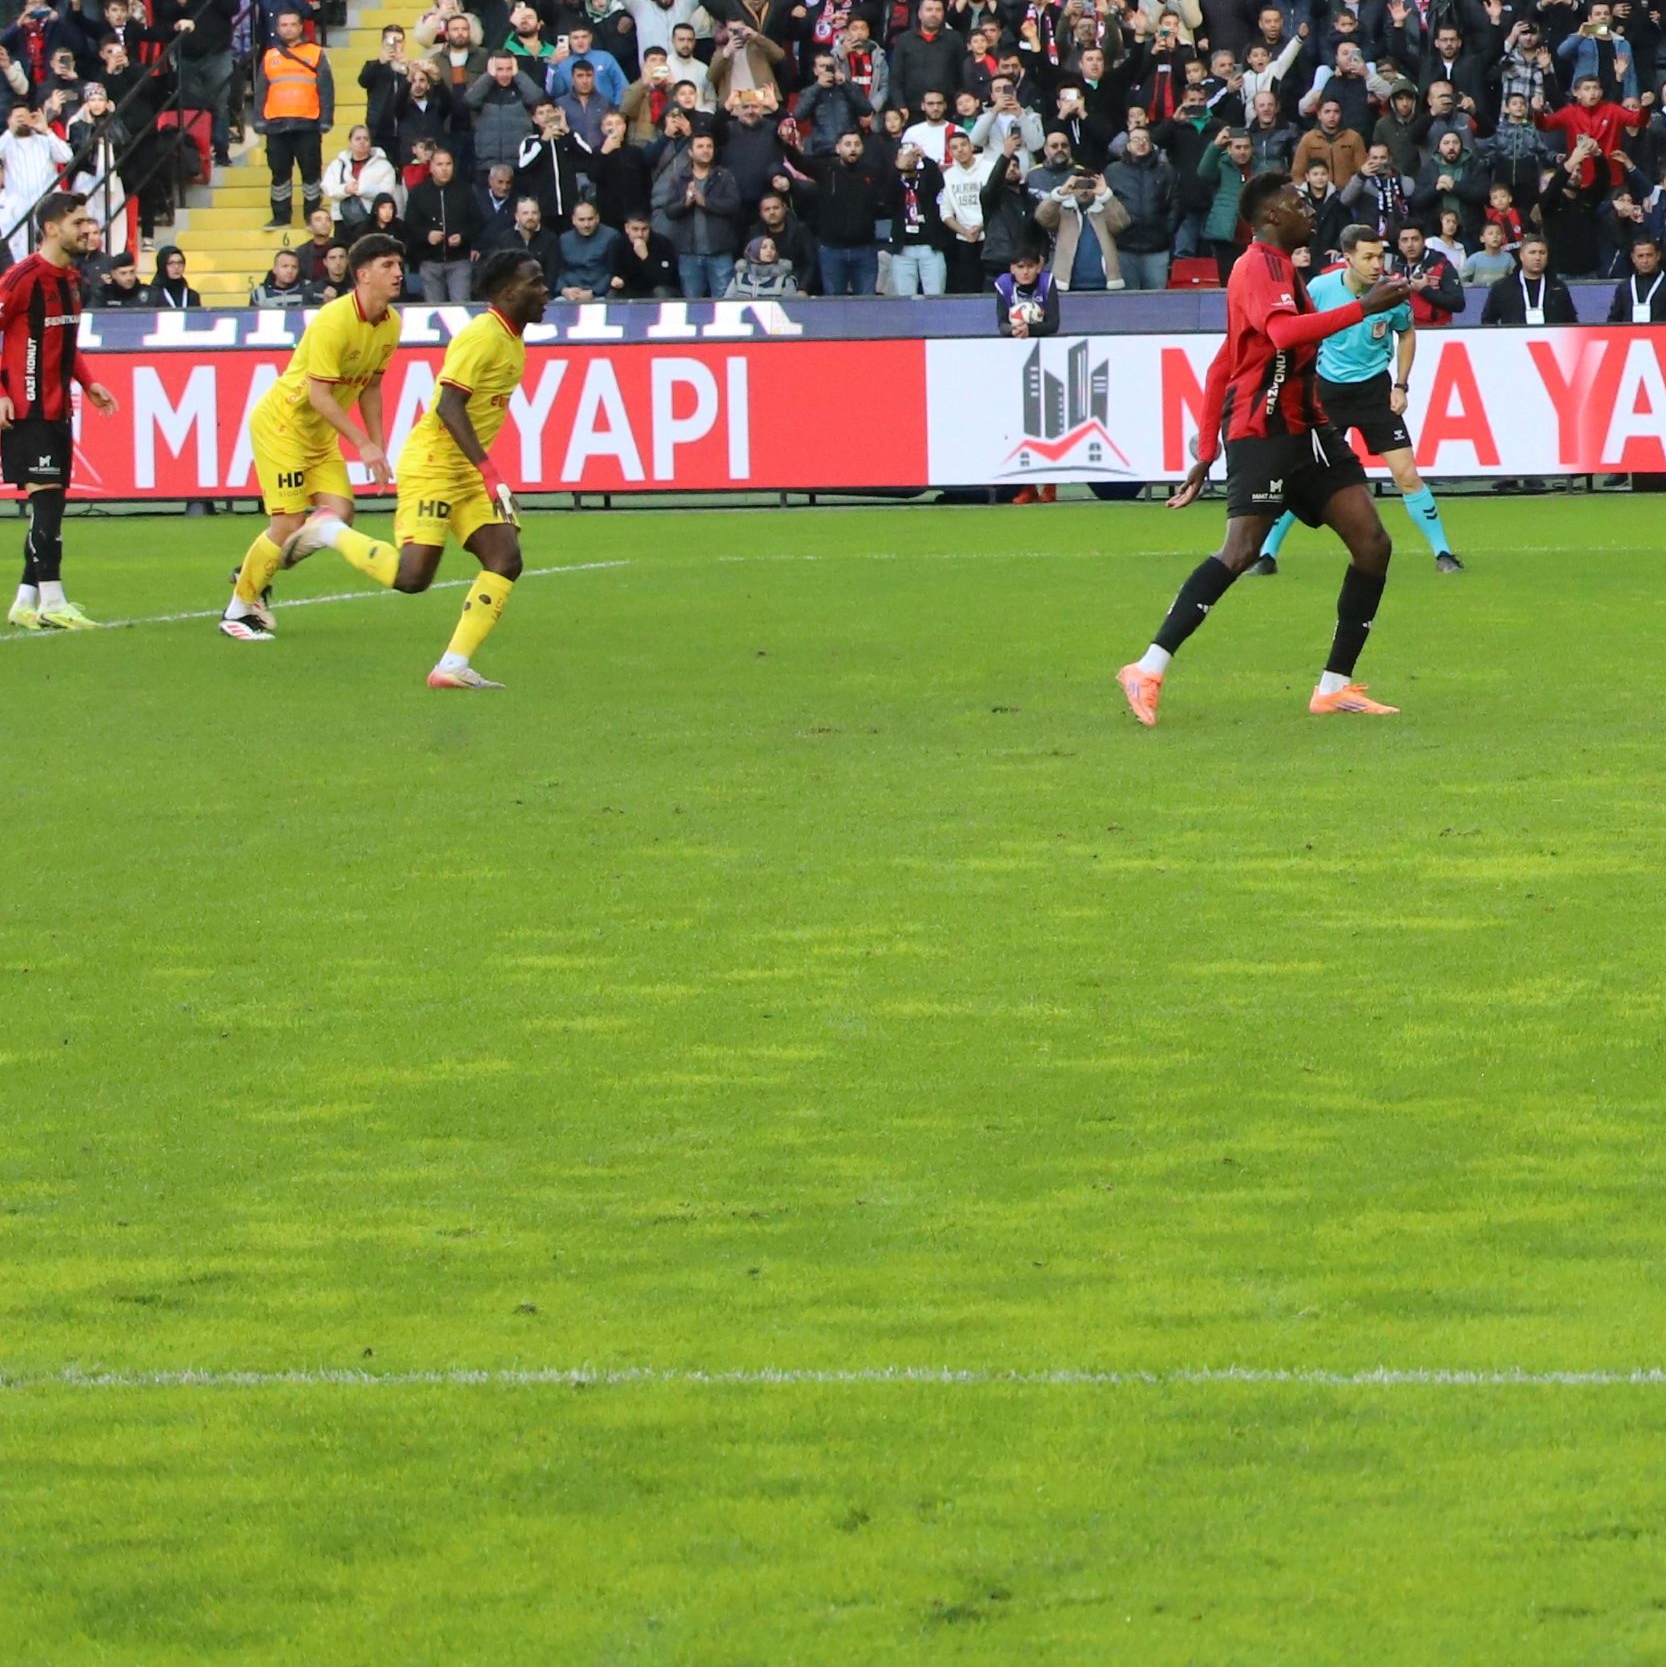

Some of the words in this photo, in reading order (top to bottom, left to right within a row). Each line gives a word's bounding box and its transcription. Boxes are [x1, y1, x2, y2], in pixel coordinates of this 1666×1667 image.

[283, 232, 291, 248] 6
[508, 356, 750, 483] YAPI
[278, 471, 304, 489] HD
[418, 499, 452, 519] HD
